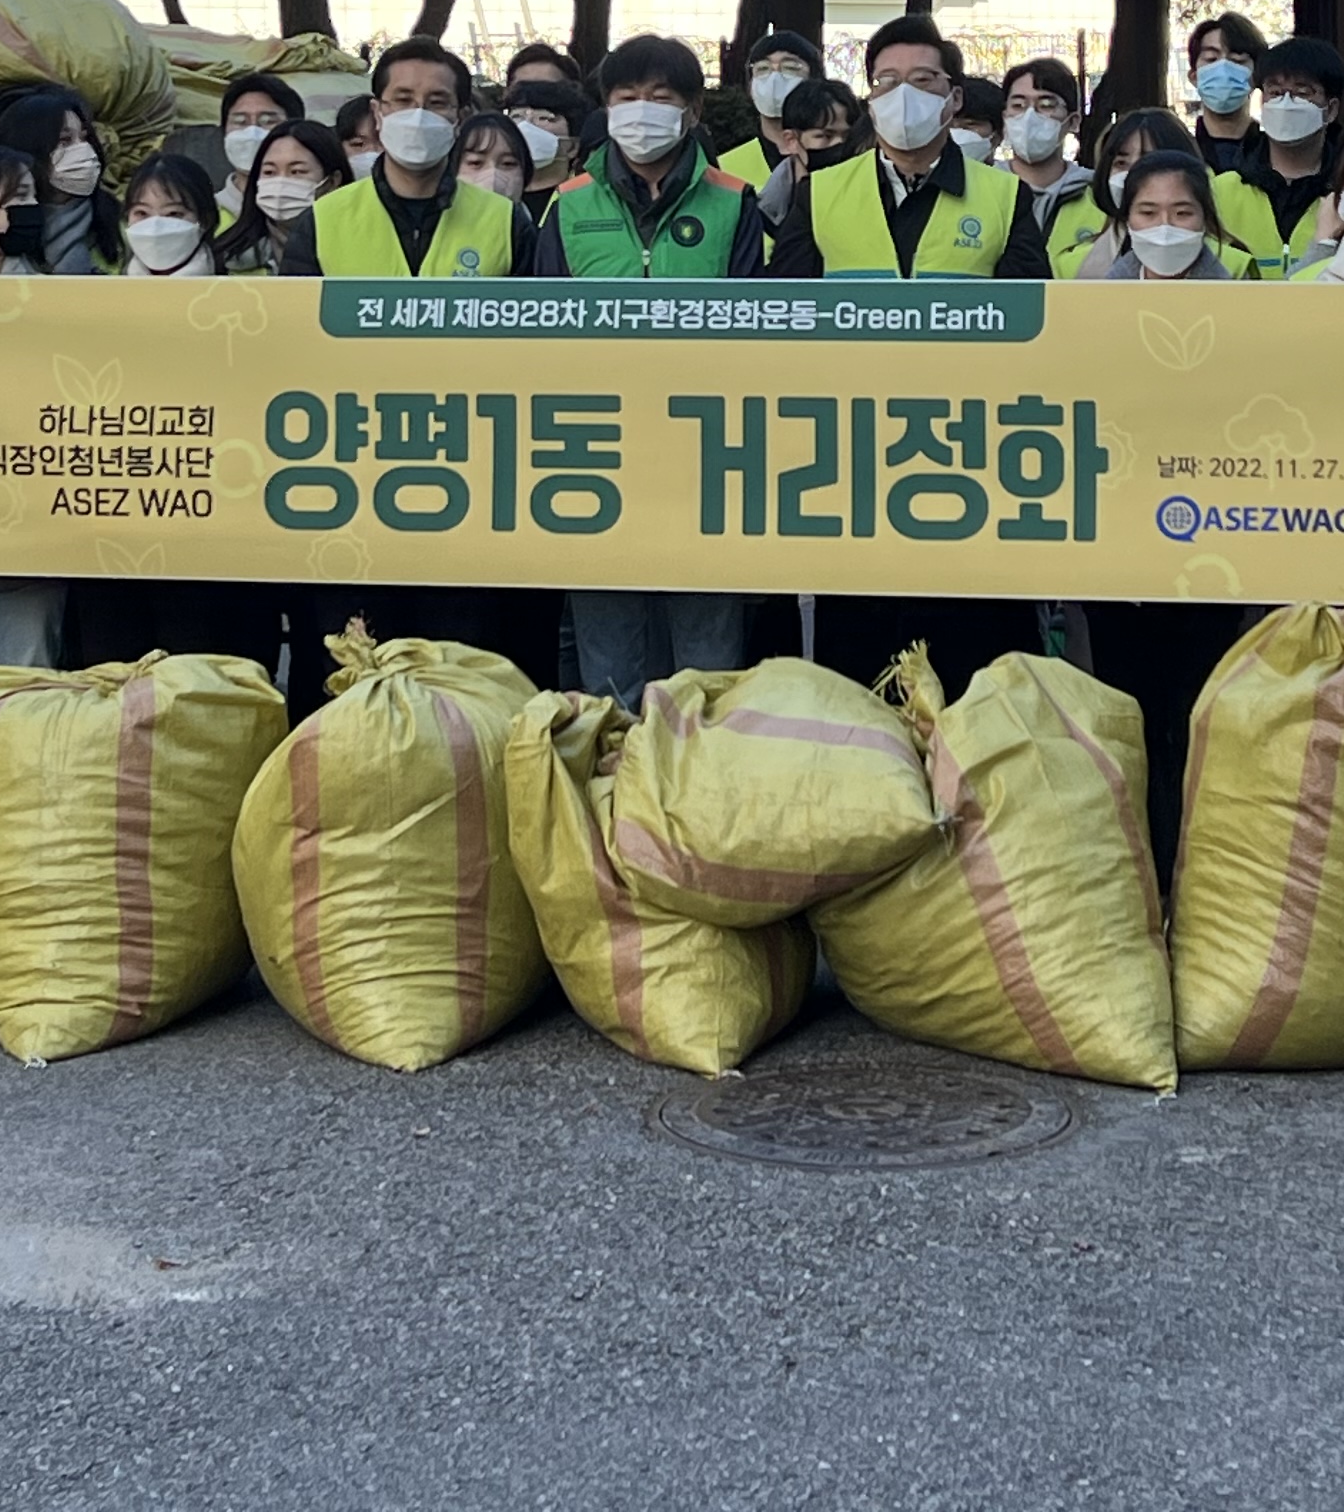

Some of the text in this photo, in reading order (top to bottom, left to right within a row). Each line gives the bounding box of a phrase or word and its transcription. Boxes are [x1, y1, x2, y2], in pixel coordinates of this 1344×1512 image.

[357, 298, 384, 328] 전
[390, 298, 446, 328] 세계
[452, 298, 588, 329] 제6928차
[930, 302, 1005, 330] Earth
[39, 404, 215, 437] 하나님의교회
[264, 390, 1109, 542] 양평1동 거리정화
[1157, 454, 1203, 479] 날짜:
[1209, 457, 1270, 478] 2022.
[1275, 458, 1305, 479] 11.
[50, 487, 213, 518] ASEZ WAO
